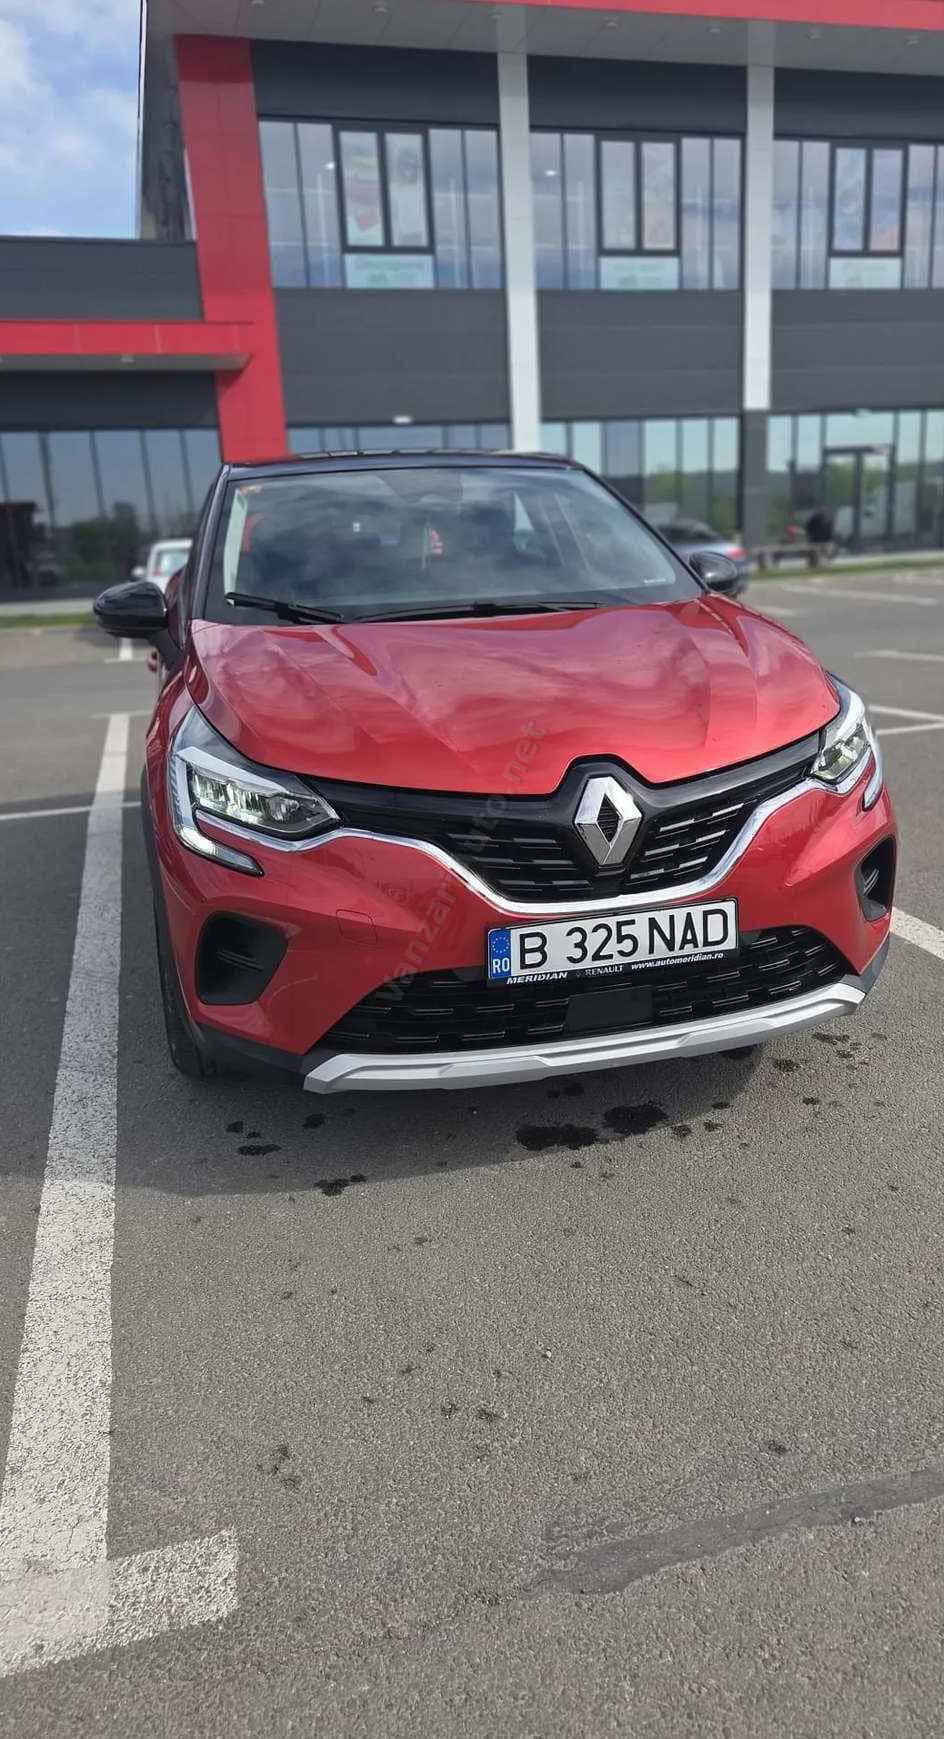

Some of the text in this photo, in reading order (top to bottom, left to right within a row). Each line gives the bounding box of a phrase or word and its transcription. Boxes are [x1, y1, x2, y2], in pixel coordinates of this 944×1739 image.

[519, 908, 729, 971] B 325 NAD
[493, 957, 510, 974] RO
[506, 952, 724, 985] MERIDIAN RENAULT www.automeridian.ro
